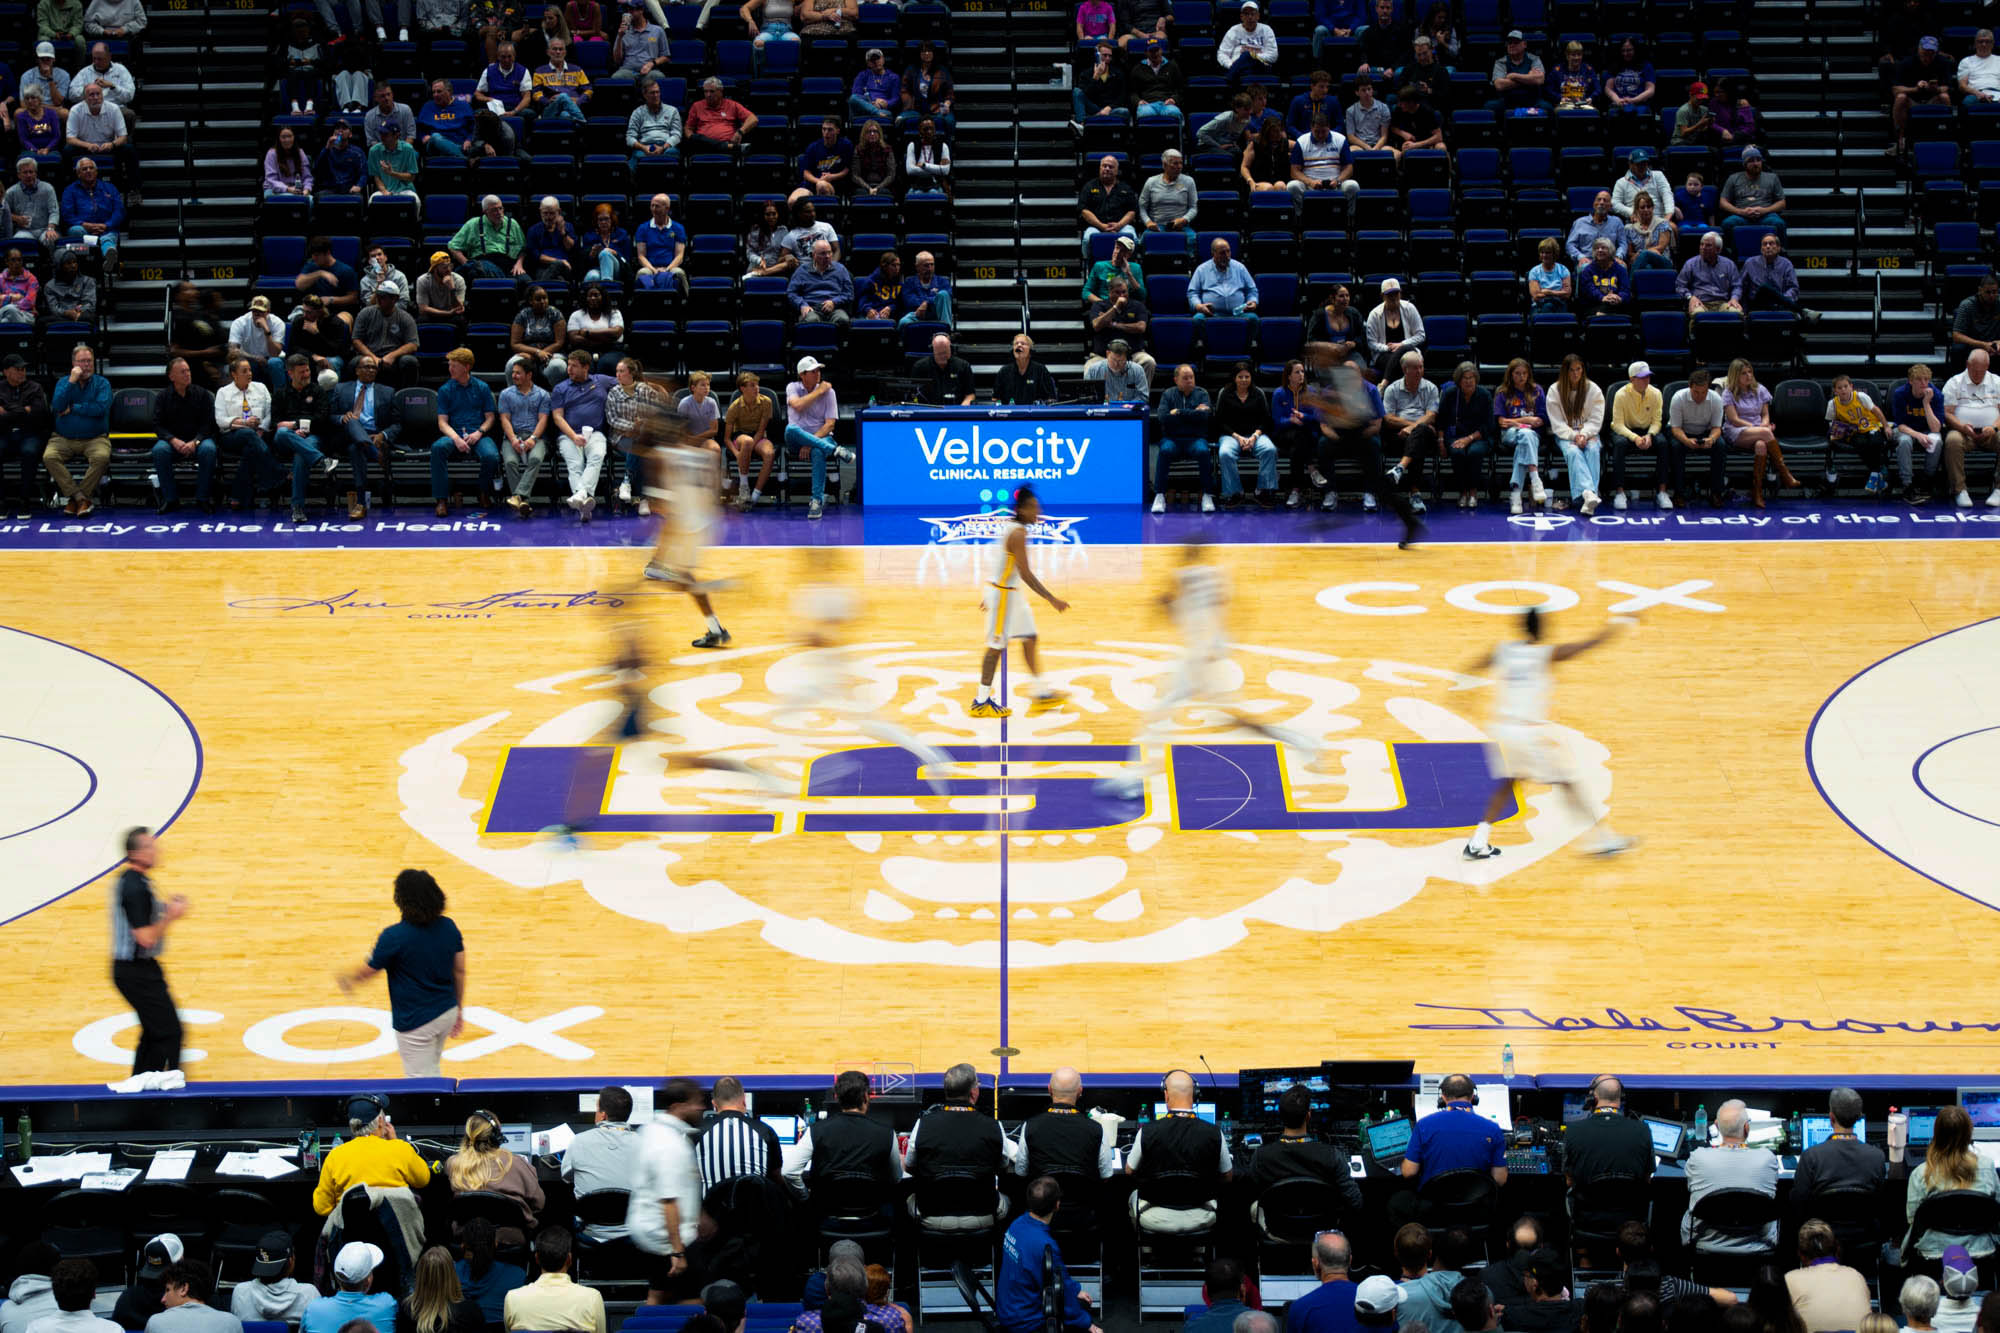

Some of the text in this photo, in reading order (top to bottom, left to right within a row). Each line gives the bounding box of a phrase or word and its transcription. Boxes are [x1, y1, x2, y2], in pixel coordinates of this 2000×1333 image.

[168, 0, 188, 10] 102
[964, 1, 984, 11] 103
[1029, 1, 1048, 11] 104
[434, 112, 456, 121] LSU
[1805, 256, 1828, 269] 104
[1877, 256, 1900, 269] 105
[141, 268, 164, 280] 102
[210, 266, 235, 279] 103
[974, 267, 996, 279] 103
[1044, 266, 1067, 279] 104
[873, 281, 903, 301] LSU
[915, 425, 1091, 476] Velocity
[930, 468, 1062, 480] CLINICAL RESEARCH
[1590, 513, 2000, 527] Our Lady of the Lake
[39, 523, 137, 535] Lady
[144, 522, 189, 533] of
[199, 523, 263, 533] the
[273, 522, 365, 532] Lake
[375, 522, 502, 532] Health
[1316, 580, 1728, 616] COX
[479, 741, 1527, 834] LSU
[73, 1006, 606, 1065] COX
